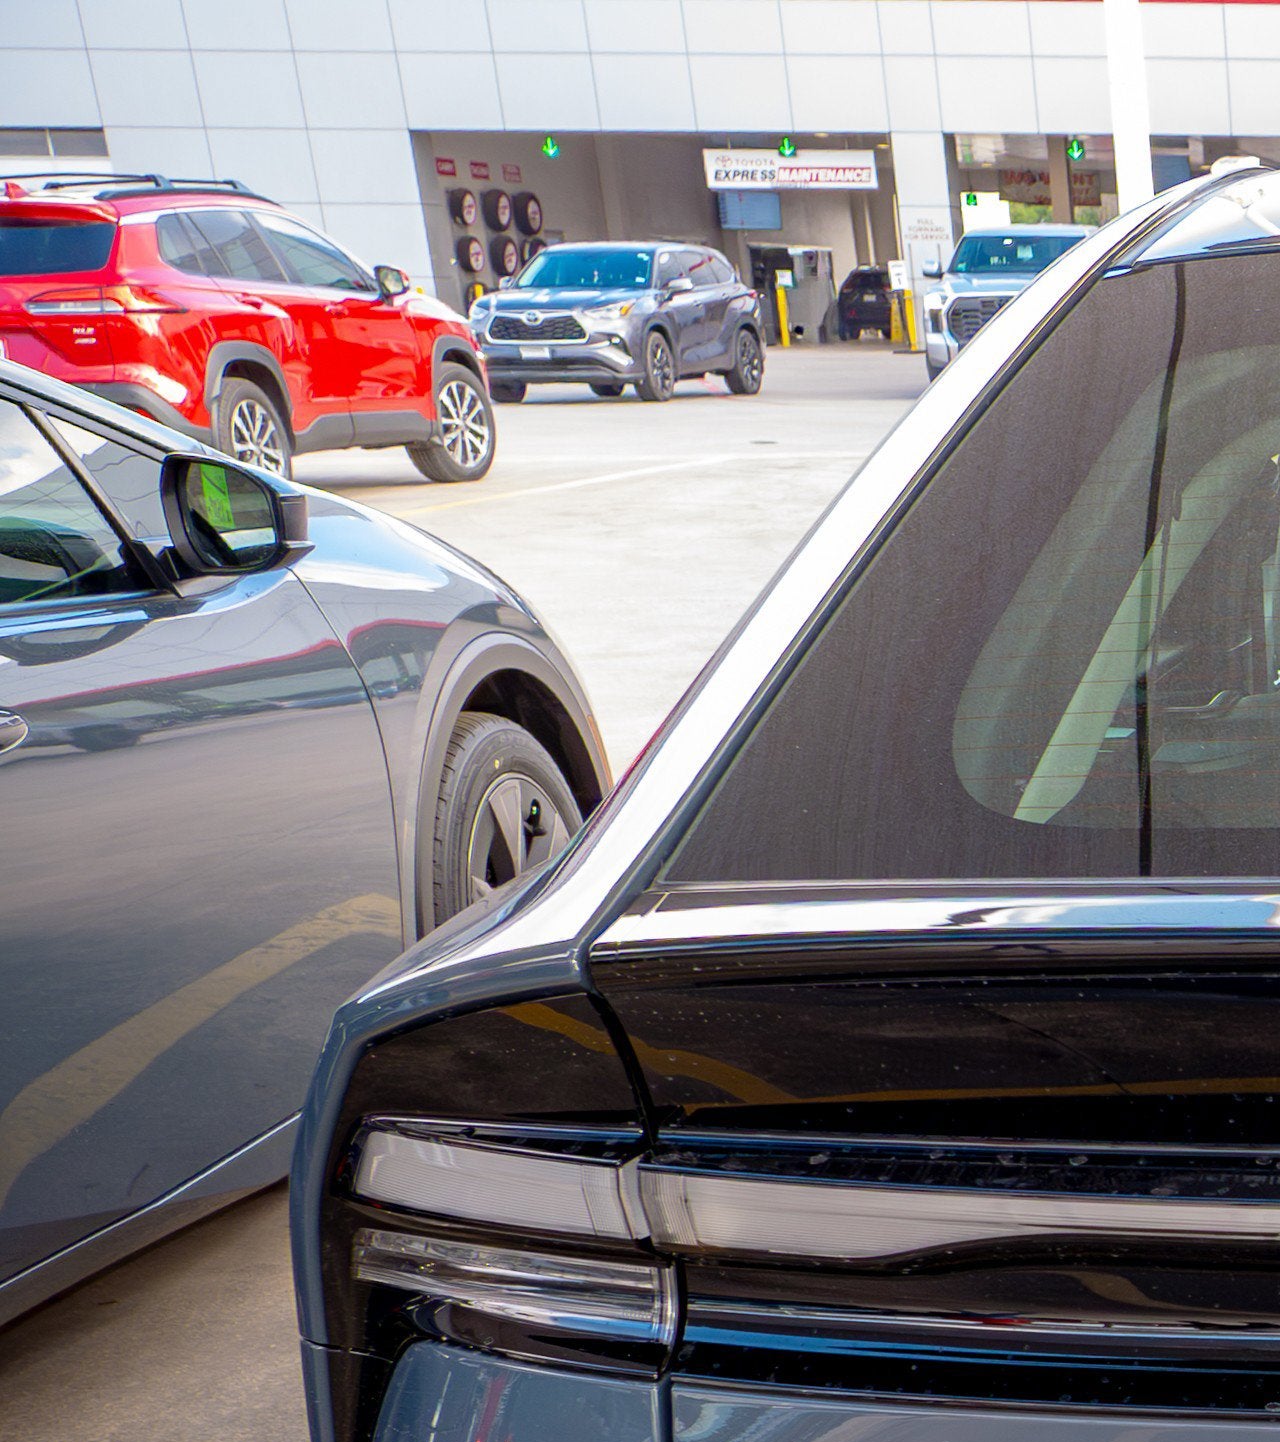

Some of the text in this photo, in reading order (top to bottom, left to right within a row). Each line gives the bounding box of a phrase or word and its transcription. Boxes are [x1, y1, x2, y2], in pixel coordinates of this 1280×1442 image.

[735, 158, 775, 167] TOYOTA
[714, 167, 872, 182] EXPRESS MAINTENANCE
